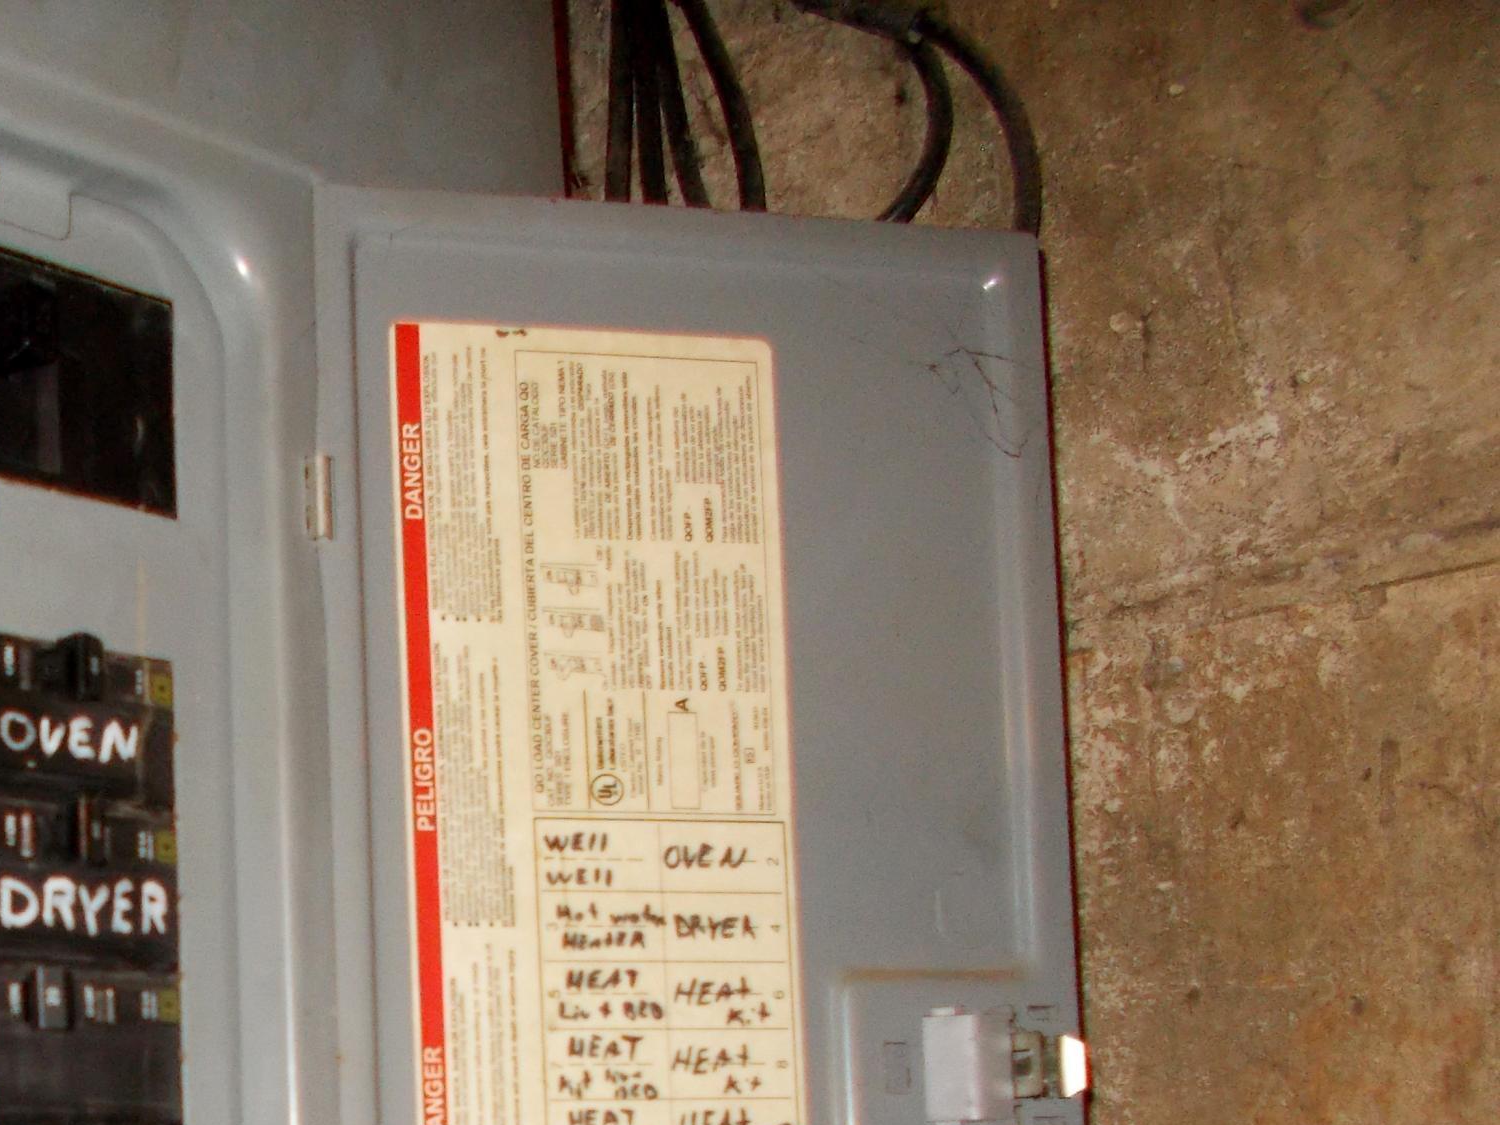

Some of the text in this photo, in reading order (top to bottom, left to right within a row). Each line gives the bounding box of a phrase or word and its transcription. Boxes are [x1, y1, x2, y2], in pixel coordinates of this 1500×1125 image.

[518, 382, 529, 401] QO
[519, 405, 530, 450] CARGA
[402, 423, 423, 520] DANGER
[520, 455, 531, 470] DE
[521, 474, 533, 527] CENTRO
[523, 532, 534, 554] DEL
[525, 558, 538, 621] CUBIERTA
[528, 632, 540, 676] COVER
[530, 680, 542, 730] CENTER
[674, 698, 689, 712] A
[0, 711, 140, 764] OVEN
[532, 734, 544, 769] LOAD
[414, 727, 435, 832] PELIGRO
[534, 773, 544, 793] QO
[664, 843, 749, 870] OVEN
[767, 857, 779, 866] 2
[0, 875, 169, 937] DRYER
[672, 913, 757, 940] DRYER
[770, 924, 781, 933] 4
[565, 968, 639, 992] HEAT
[772, 990, 785, 1000] 6
[568, 1034, 644, 1061] HEAT
